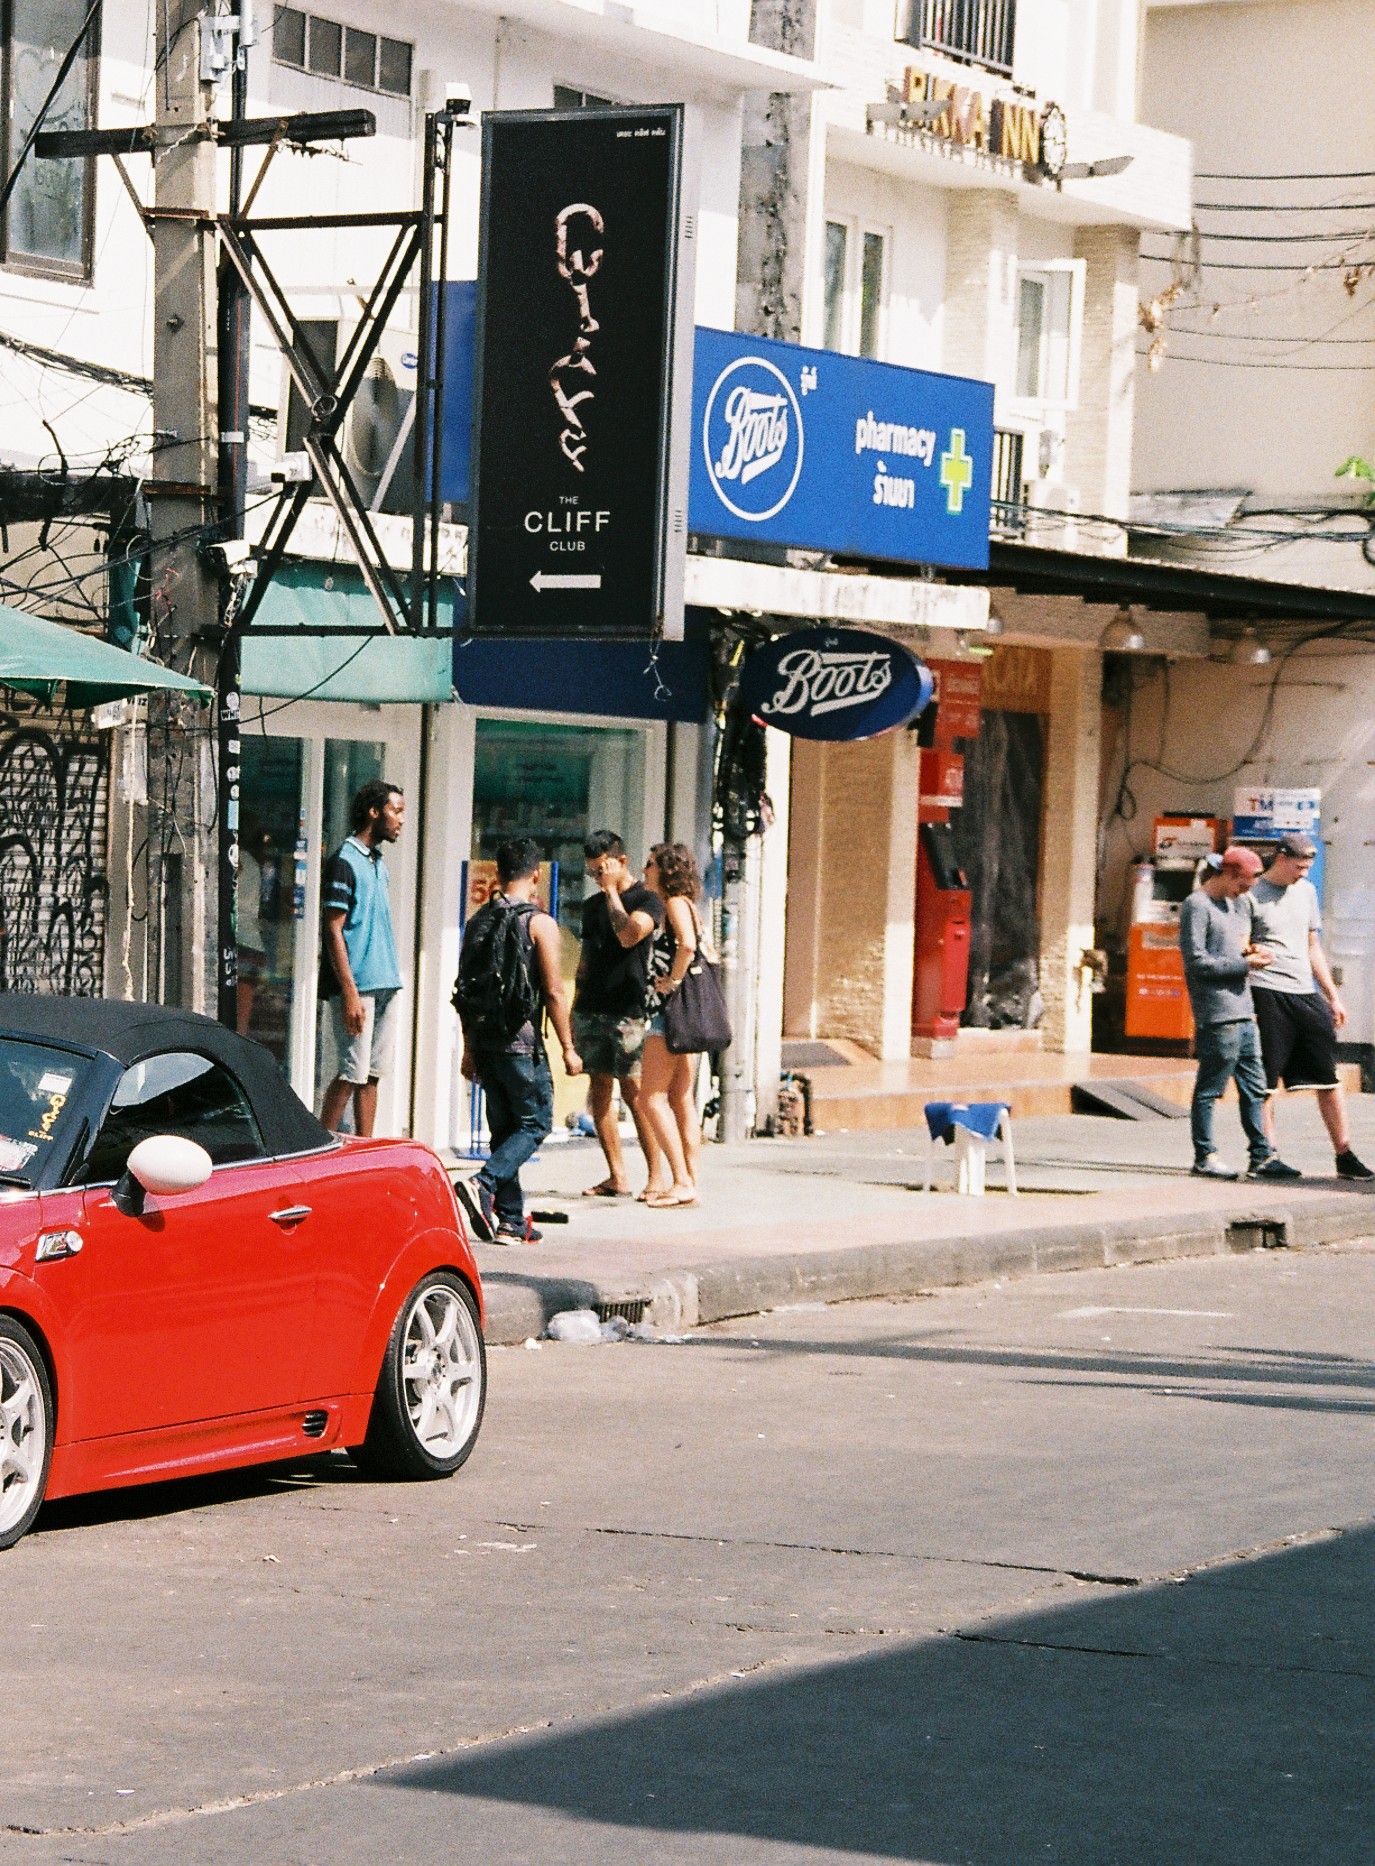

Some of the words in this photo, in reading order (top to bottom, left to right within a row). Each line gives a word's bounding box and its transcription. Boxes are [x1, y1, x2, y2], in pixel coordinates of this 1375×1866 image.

[715, 386, 788, 485] Boots
[856, 410, 936, 468] pharmacy
[559, 496, 580, 505] THE
[524, 511, 610, 533] CLIFF
[549, 541, 586, 552] CLUB
[761, 649, 892, 717] Boots
